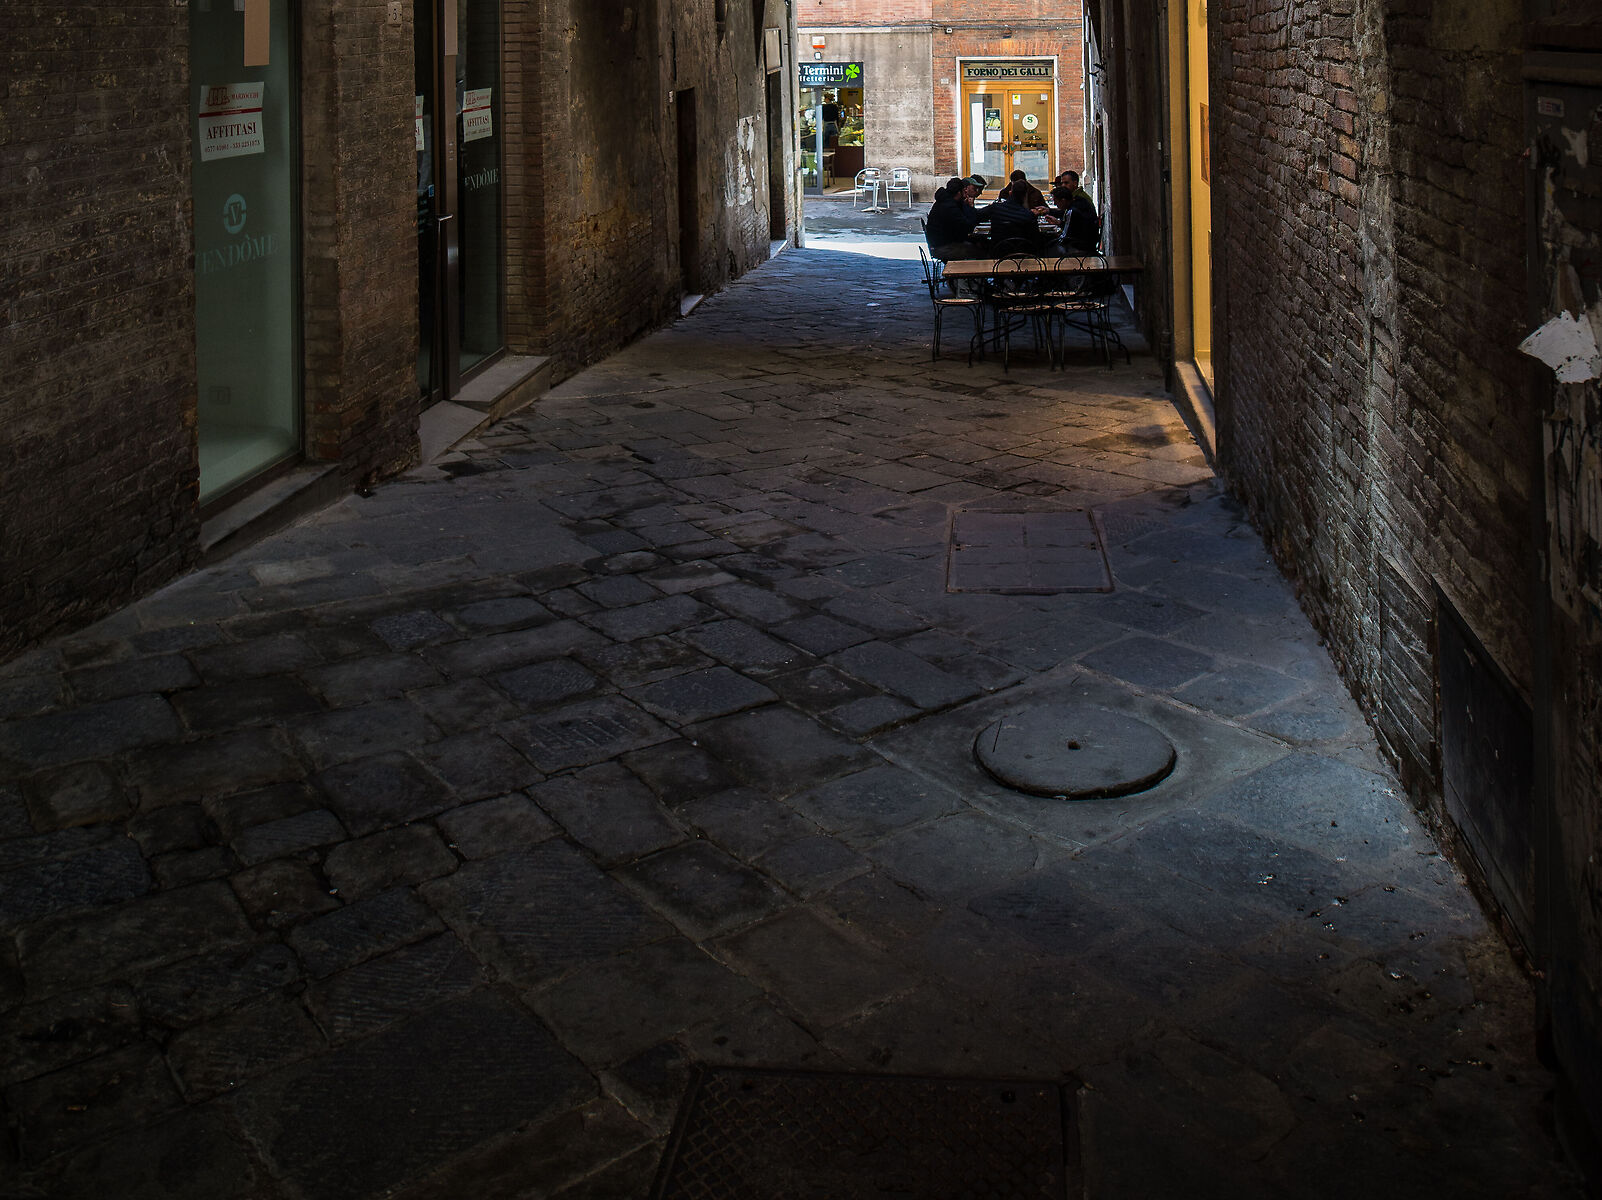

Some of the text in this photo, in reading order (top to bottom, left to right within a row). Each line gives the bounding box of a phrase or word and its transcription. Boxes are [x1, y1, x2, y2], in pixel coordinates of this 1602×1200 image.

[803, 65, 843, 75] Termini
[967, 67, 1049, 76] FORNO DEI GALLI
[207, 122, 256, 139] AFFITTASI
